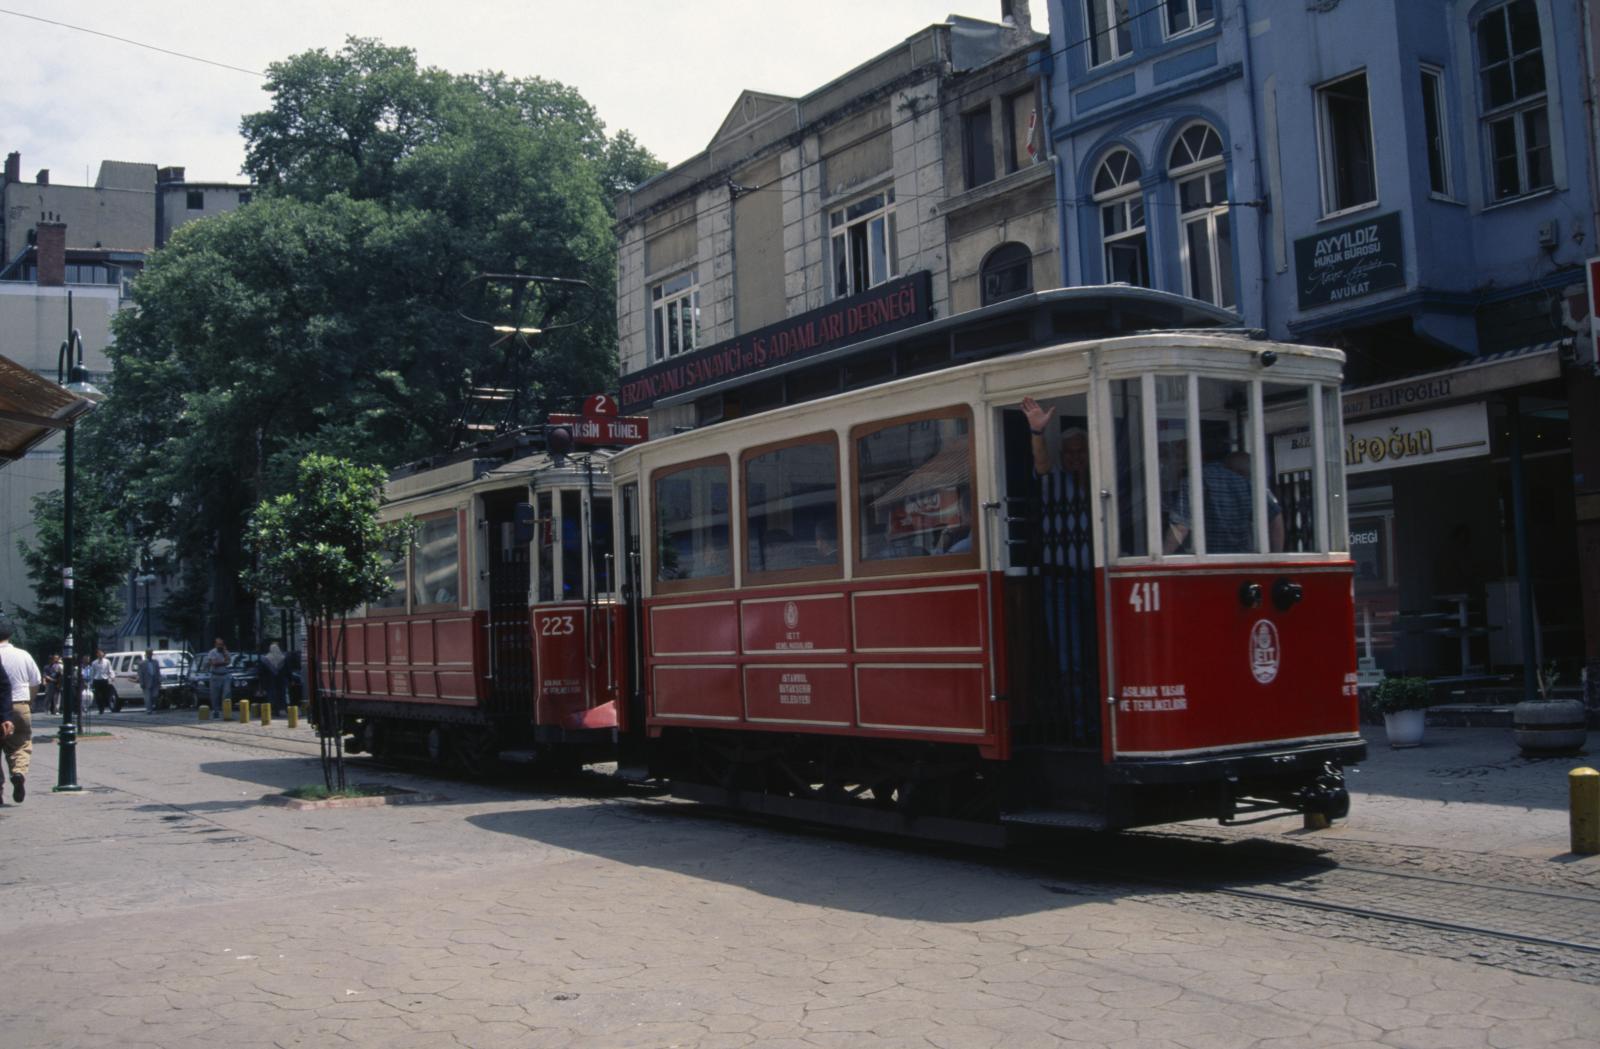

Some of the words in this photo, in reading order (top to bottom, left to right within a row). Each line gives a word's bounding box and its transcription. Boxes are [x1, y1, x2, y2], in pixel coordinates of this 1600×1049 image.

[1314, 224, 1378, 257] AYYILDIZ
[1313, 251, 1344, 268] HUKUK
[1330, 281, 1371, 301] AVUKAT
[767, 311, 844, 360] ADAMLARI
[847, 281, 916, 335] DERNEĞİ
[595, 394, 606, 413] 2
[571, 420, 600, 438] KSİM
[1344, 424, 1434, 465] İFOĞLU
[1129, 581, 1160, 613] 411
[542, 615, 575, 636] 223
